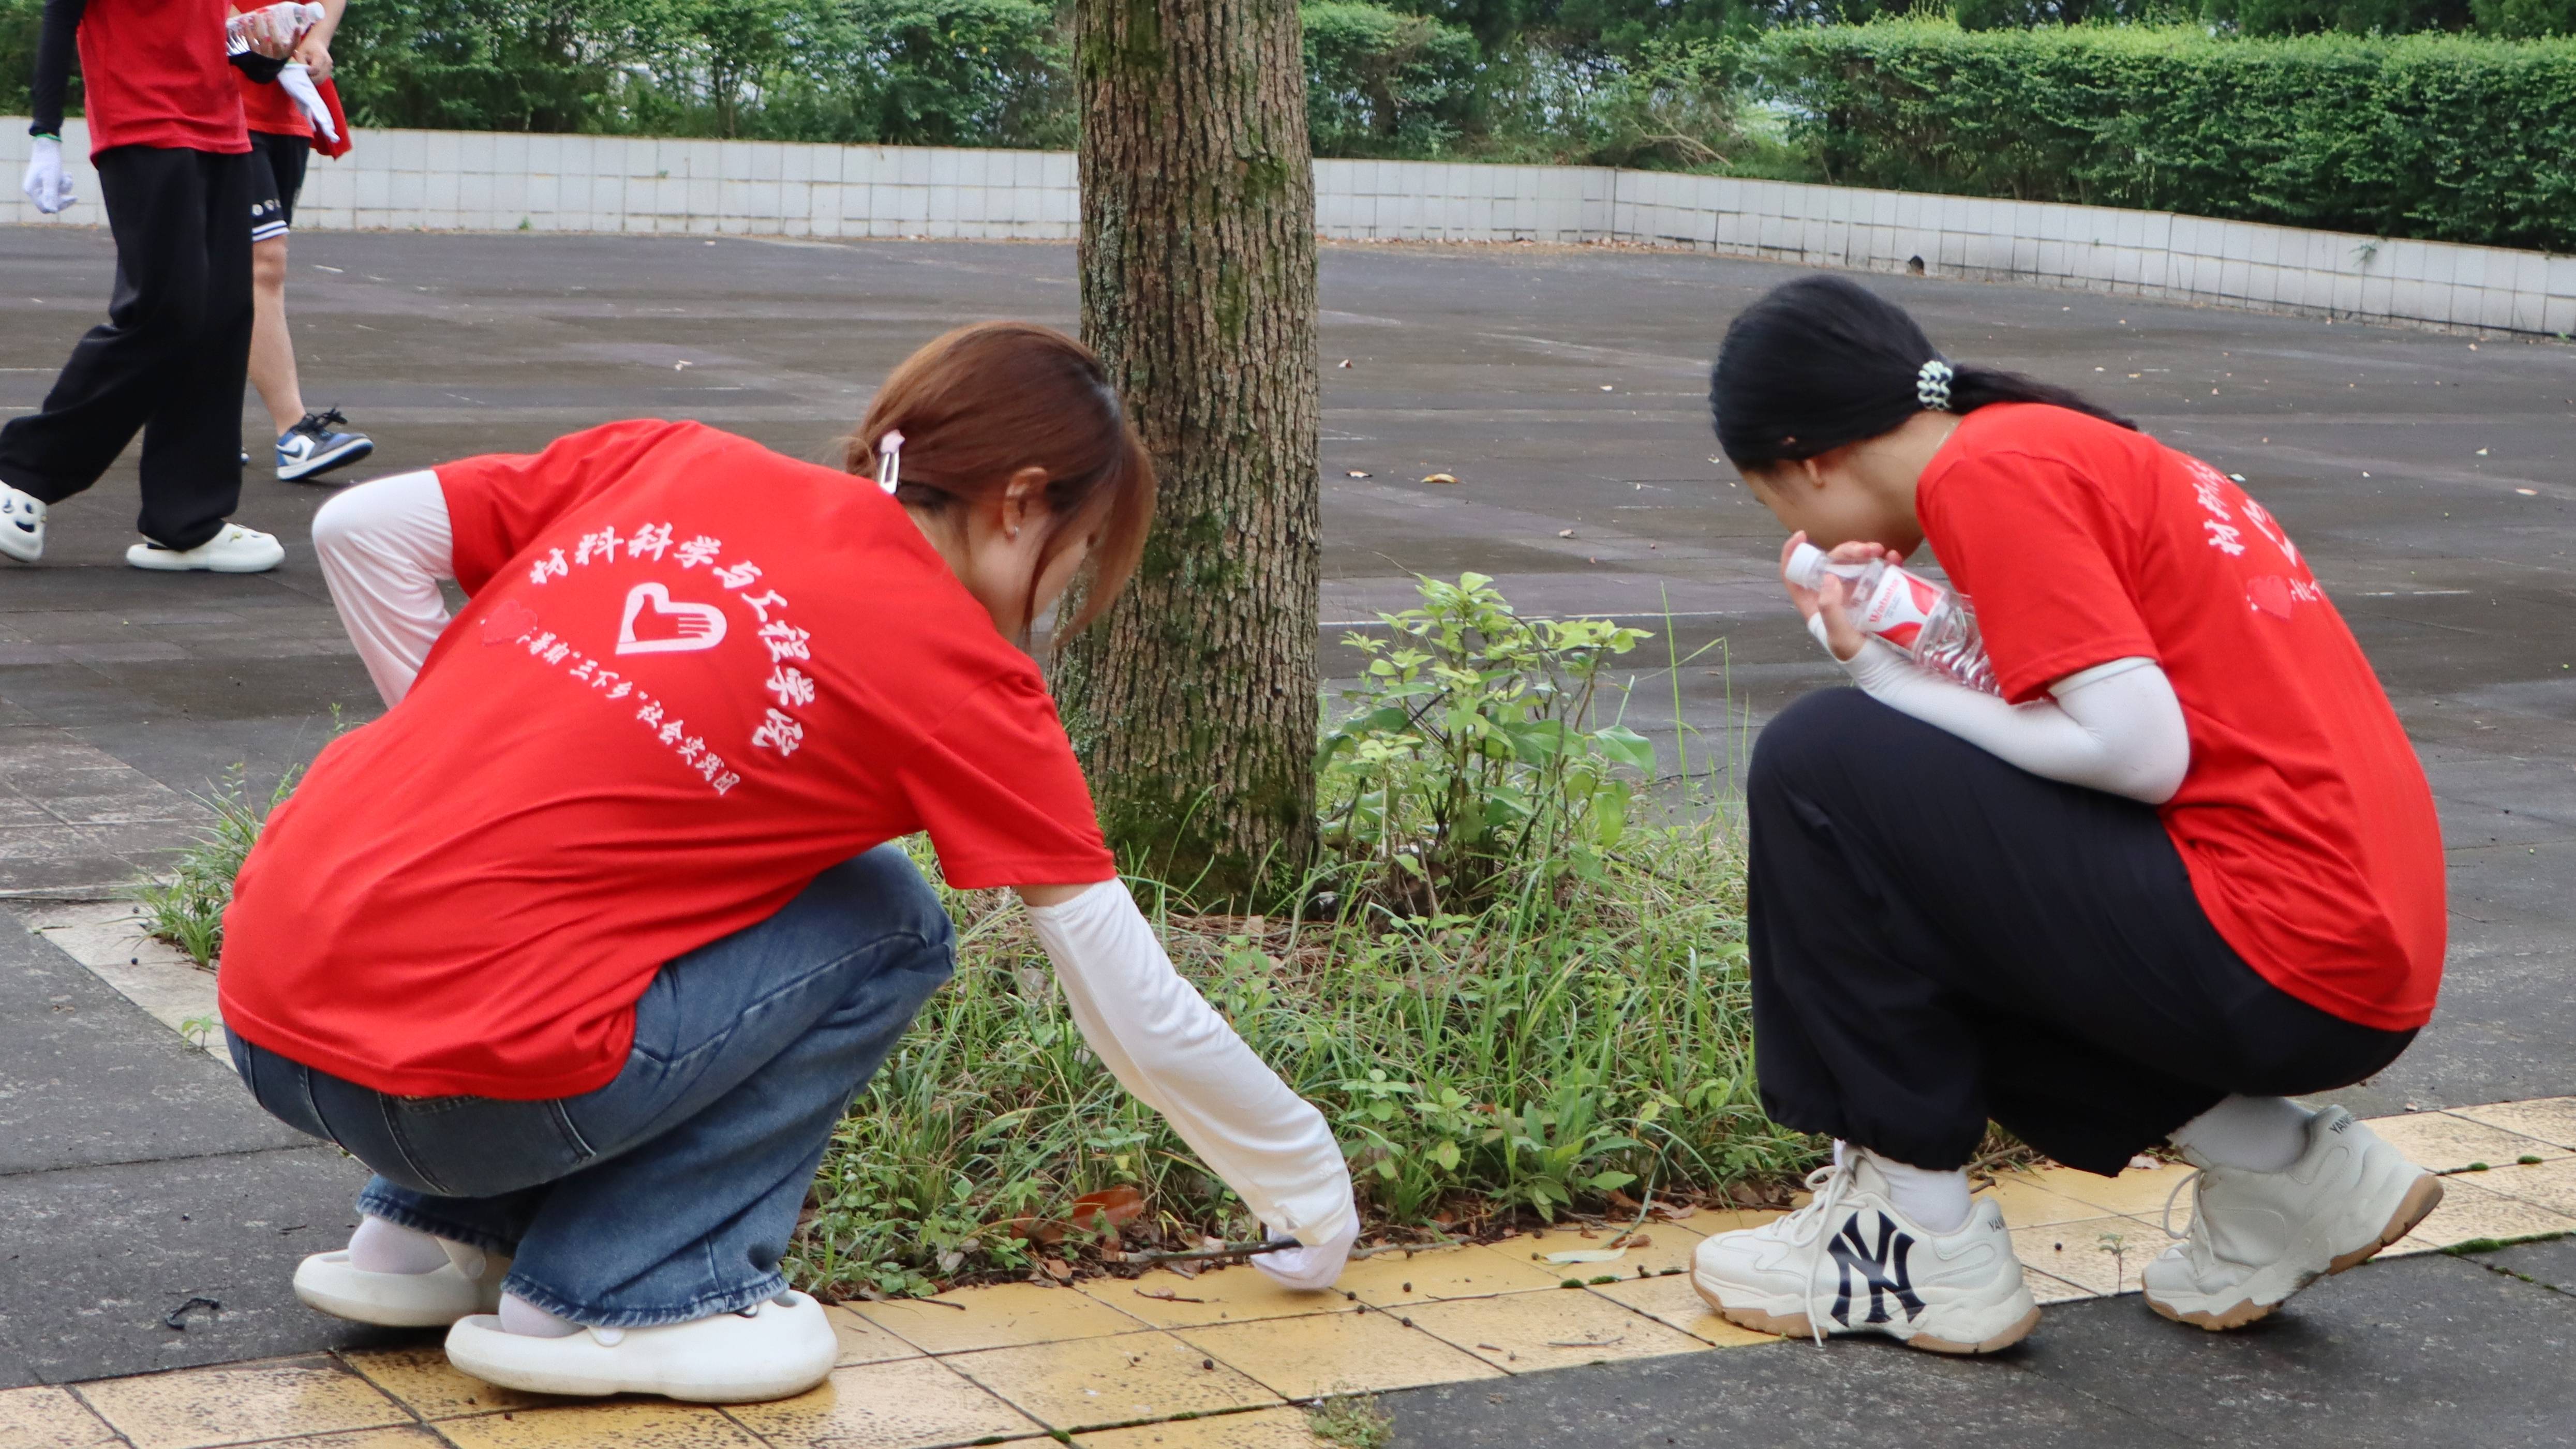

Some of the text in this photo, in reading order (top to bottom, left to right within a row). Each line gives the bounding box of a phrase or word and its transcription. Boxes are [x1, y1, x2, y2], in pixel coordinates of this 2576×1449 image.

[516, 630, 740, 796] 暑期“三下乡”社会实践团
[528, 521, 815, 756] 材料科学与工程学院
[1827, 1209, 1927, 1327] NY
